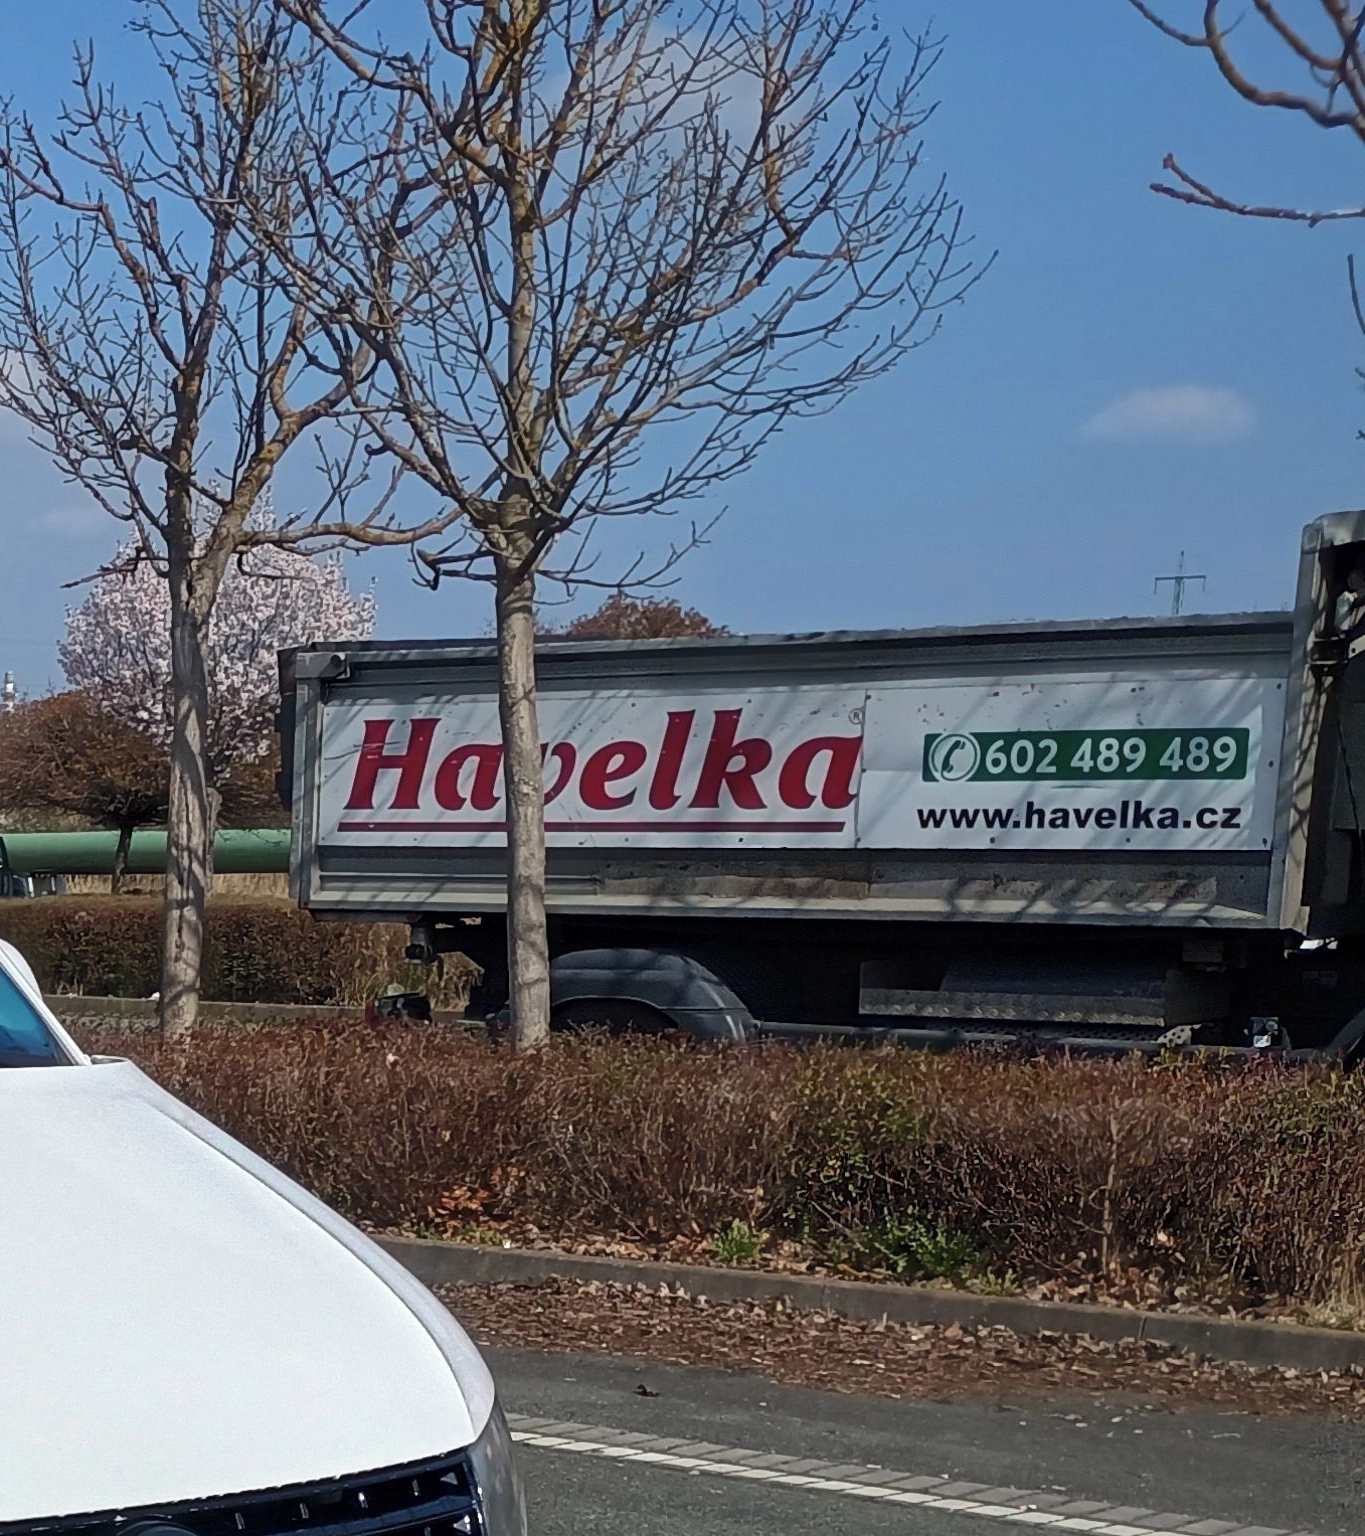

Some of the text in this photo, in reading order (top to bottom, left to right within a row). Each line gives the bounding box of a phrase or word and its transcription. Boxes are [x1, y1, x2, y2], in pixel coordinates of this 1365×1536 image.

[985, 736, 1237, 774] 602 489 489
[917, 800, 1242, 829] www.havelka.cz
